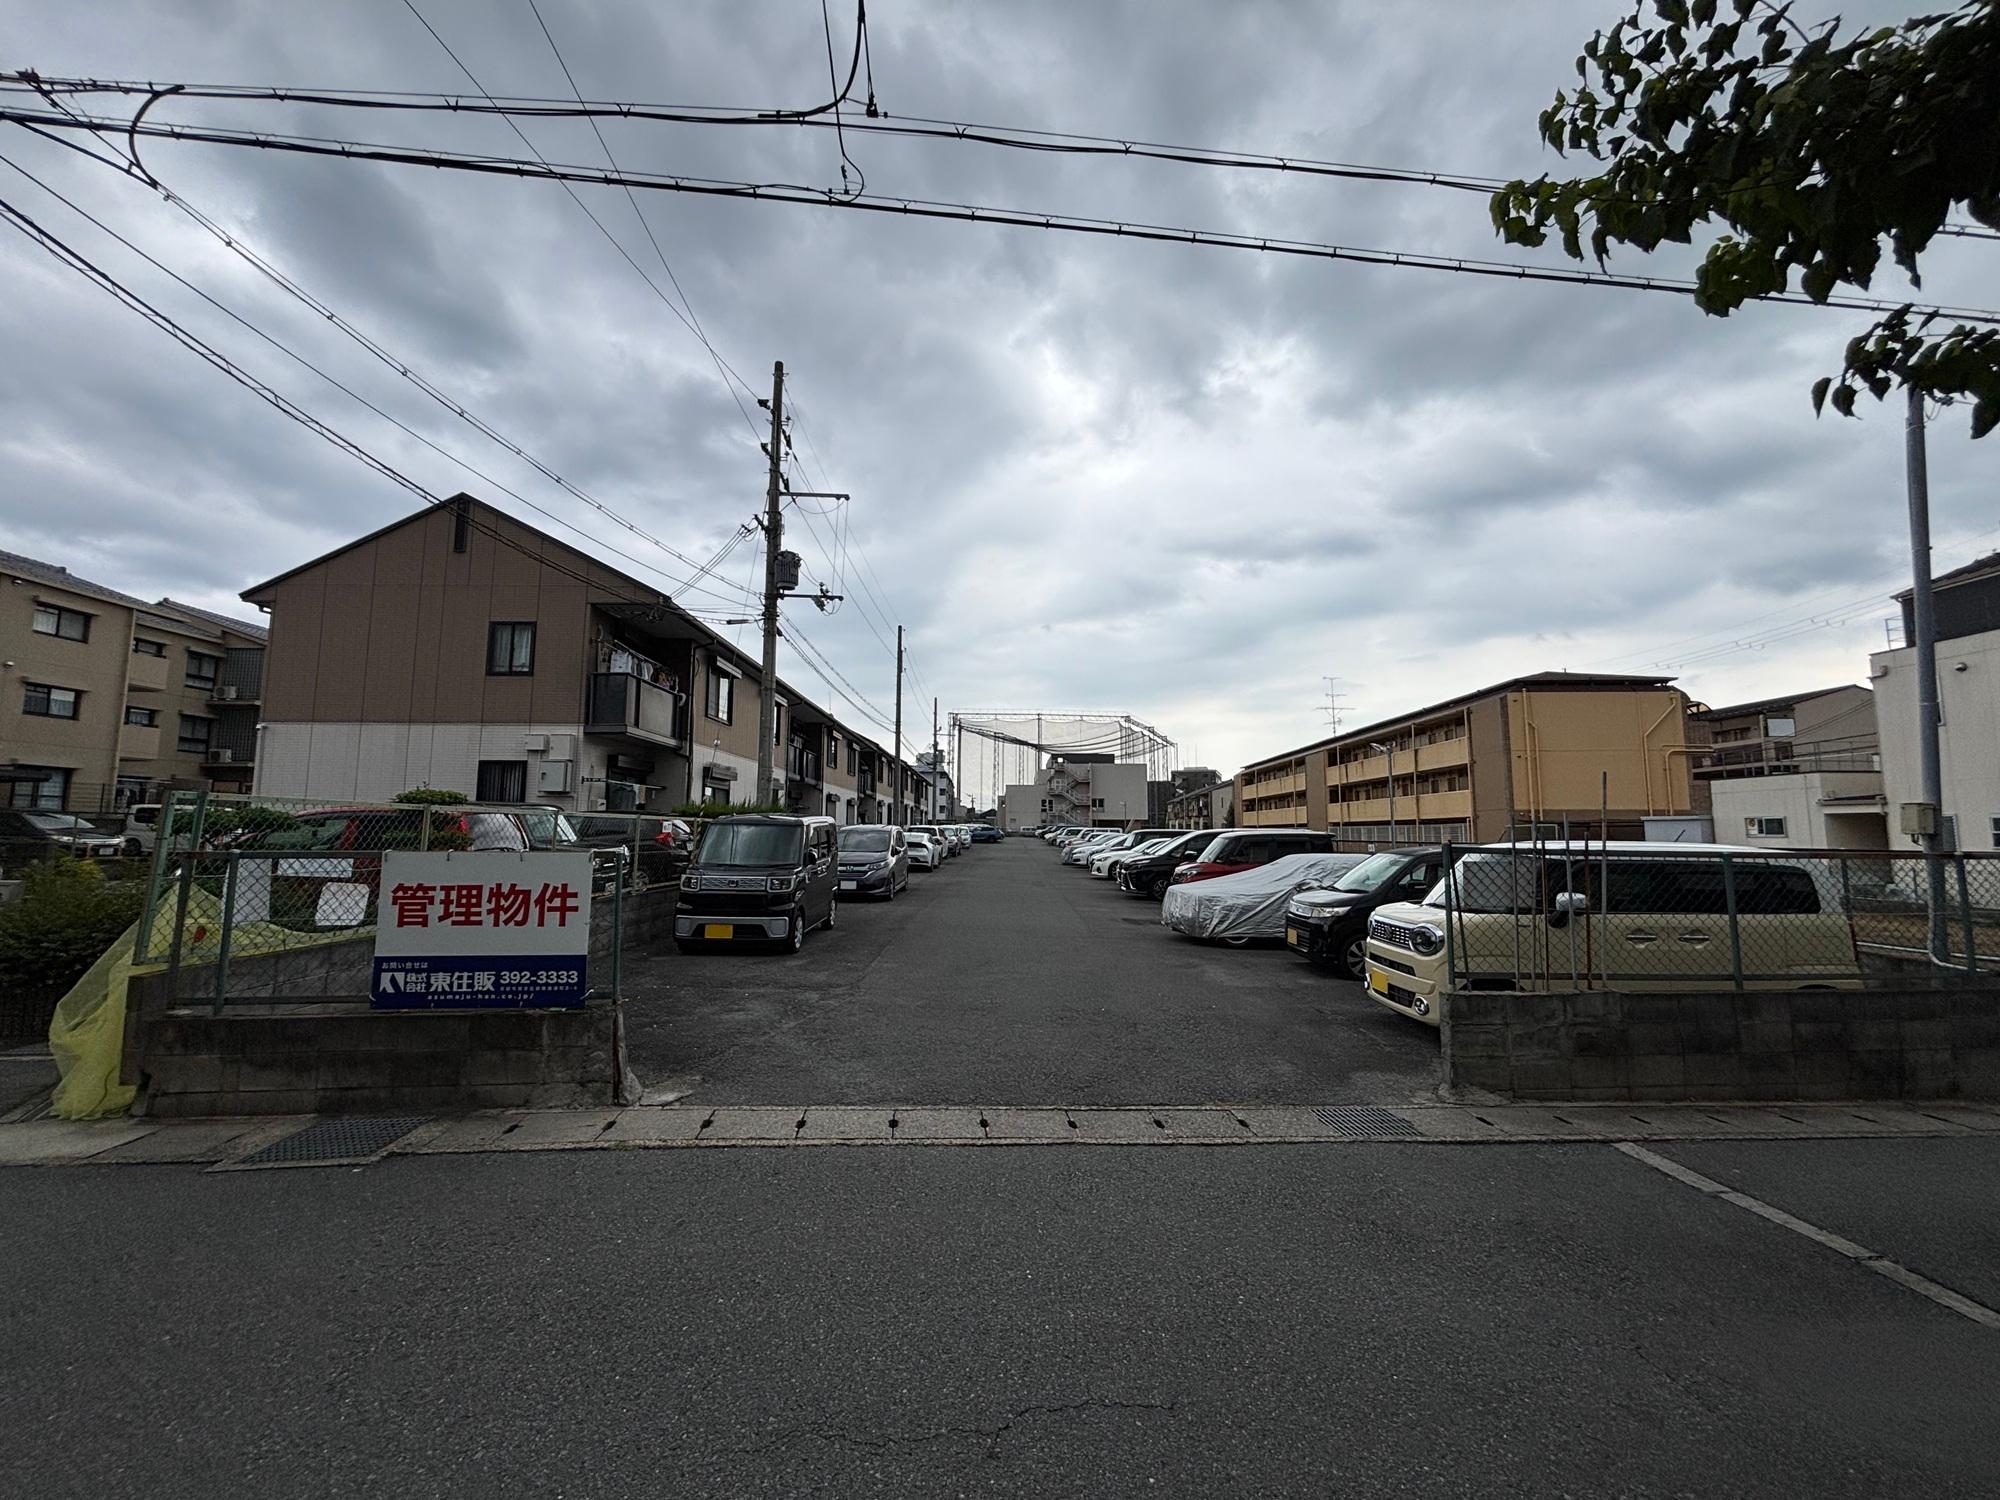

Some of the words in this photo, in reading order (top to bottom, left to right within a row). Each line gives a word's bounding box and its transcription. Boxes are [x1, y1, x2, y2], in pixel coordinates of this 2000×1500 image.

[391, 883, 579, 928] 管理物件
[430, 972, 496, 992] 東住販
[500, 971, 578, 984] 392-3333
